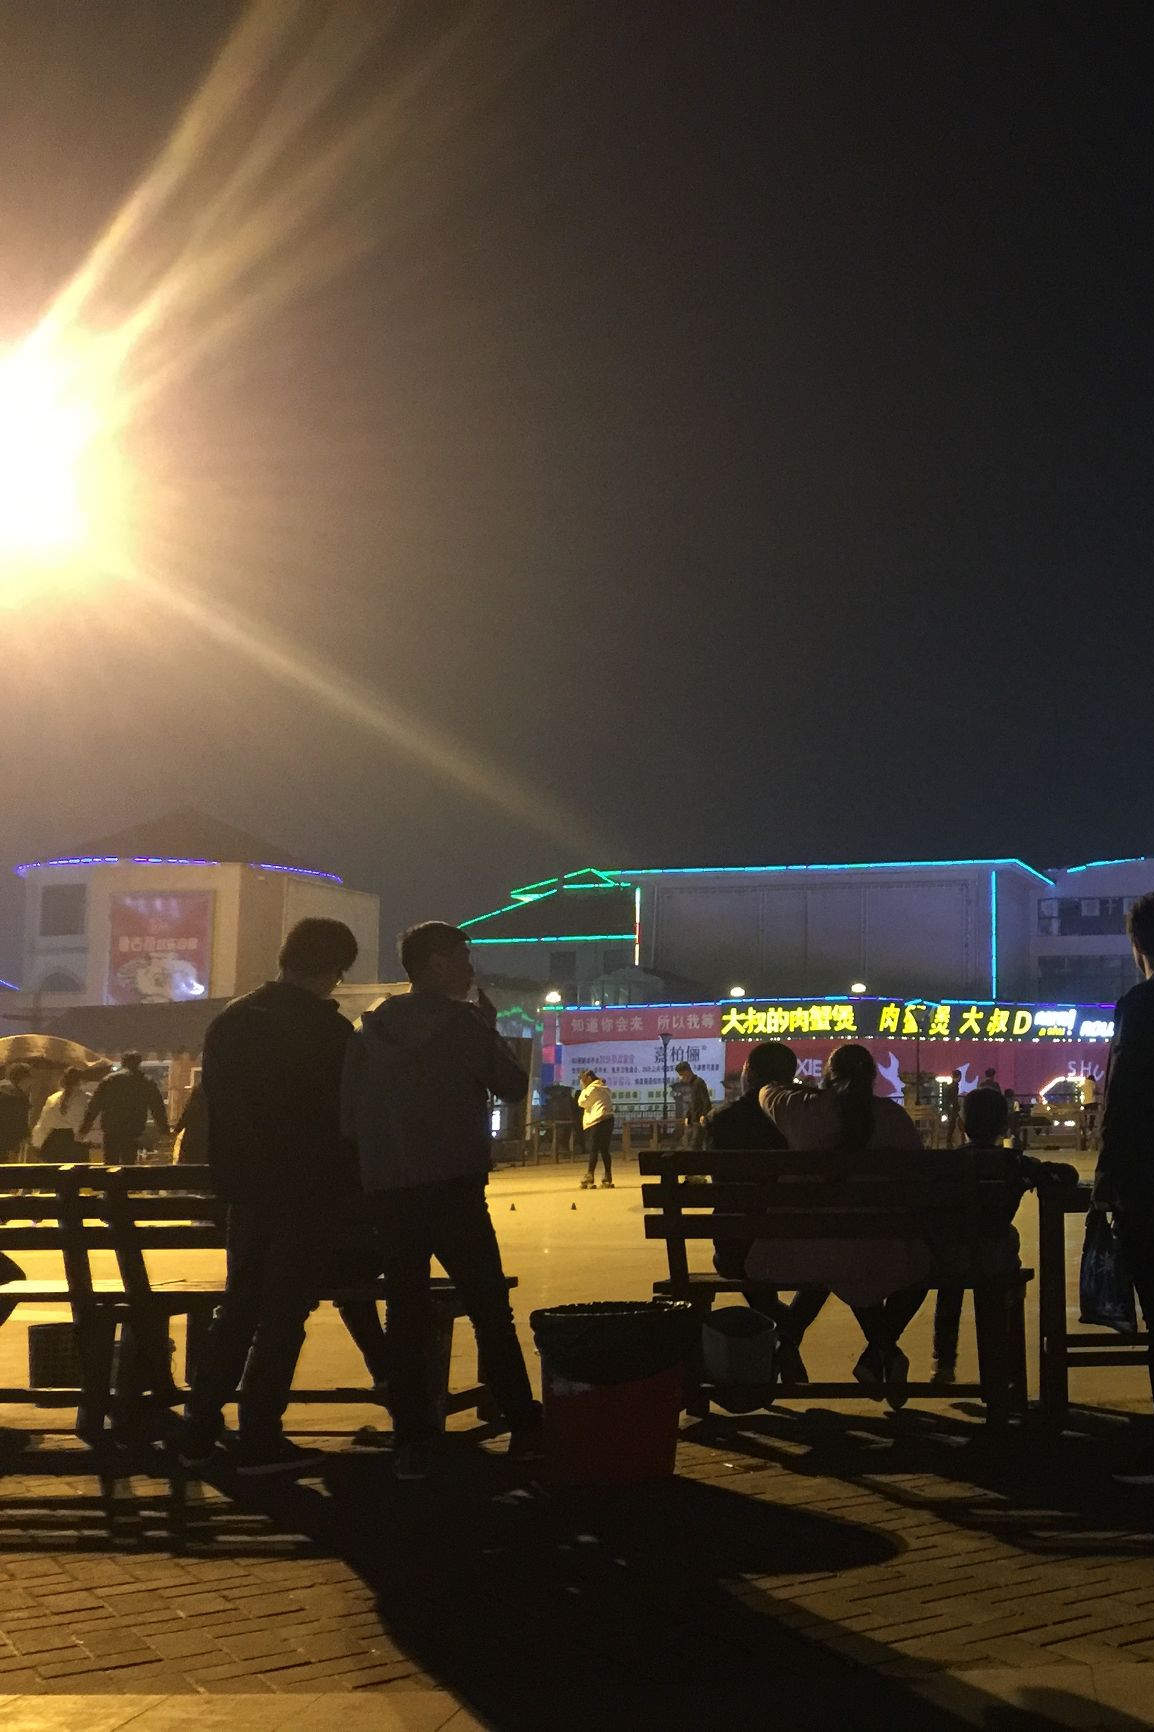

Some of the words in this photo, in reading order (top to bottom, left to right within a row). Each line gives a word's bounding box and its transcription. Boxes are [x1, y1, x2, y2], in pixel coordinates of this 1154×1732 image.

[571, 1016, 644, 1033] 知道你会来
[657, 1014, 715, 1030] 所以我等
[721, 1004, 857, 1034] 大叔的肉蟹煲
